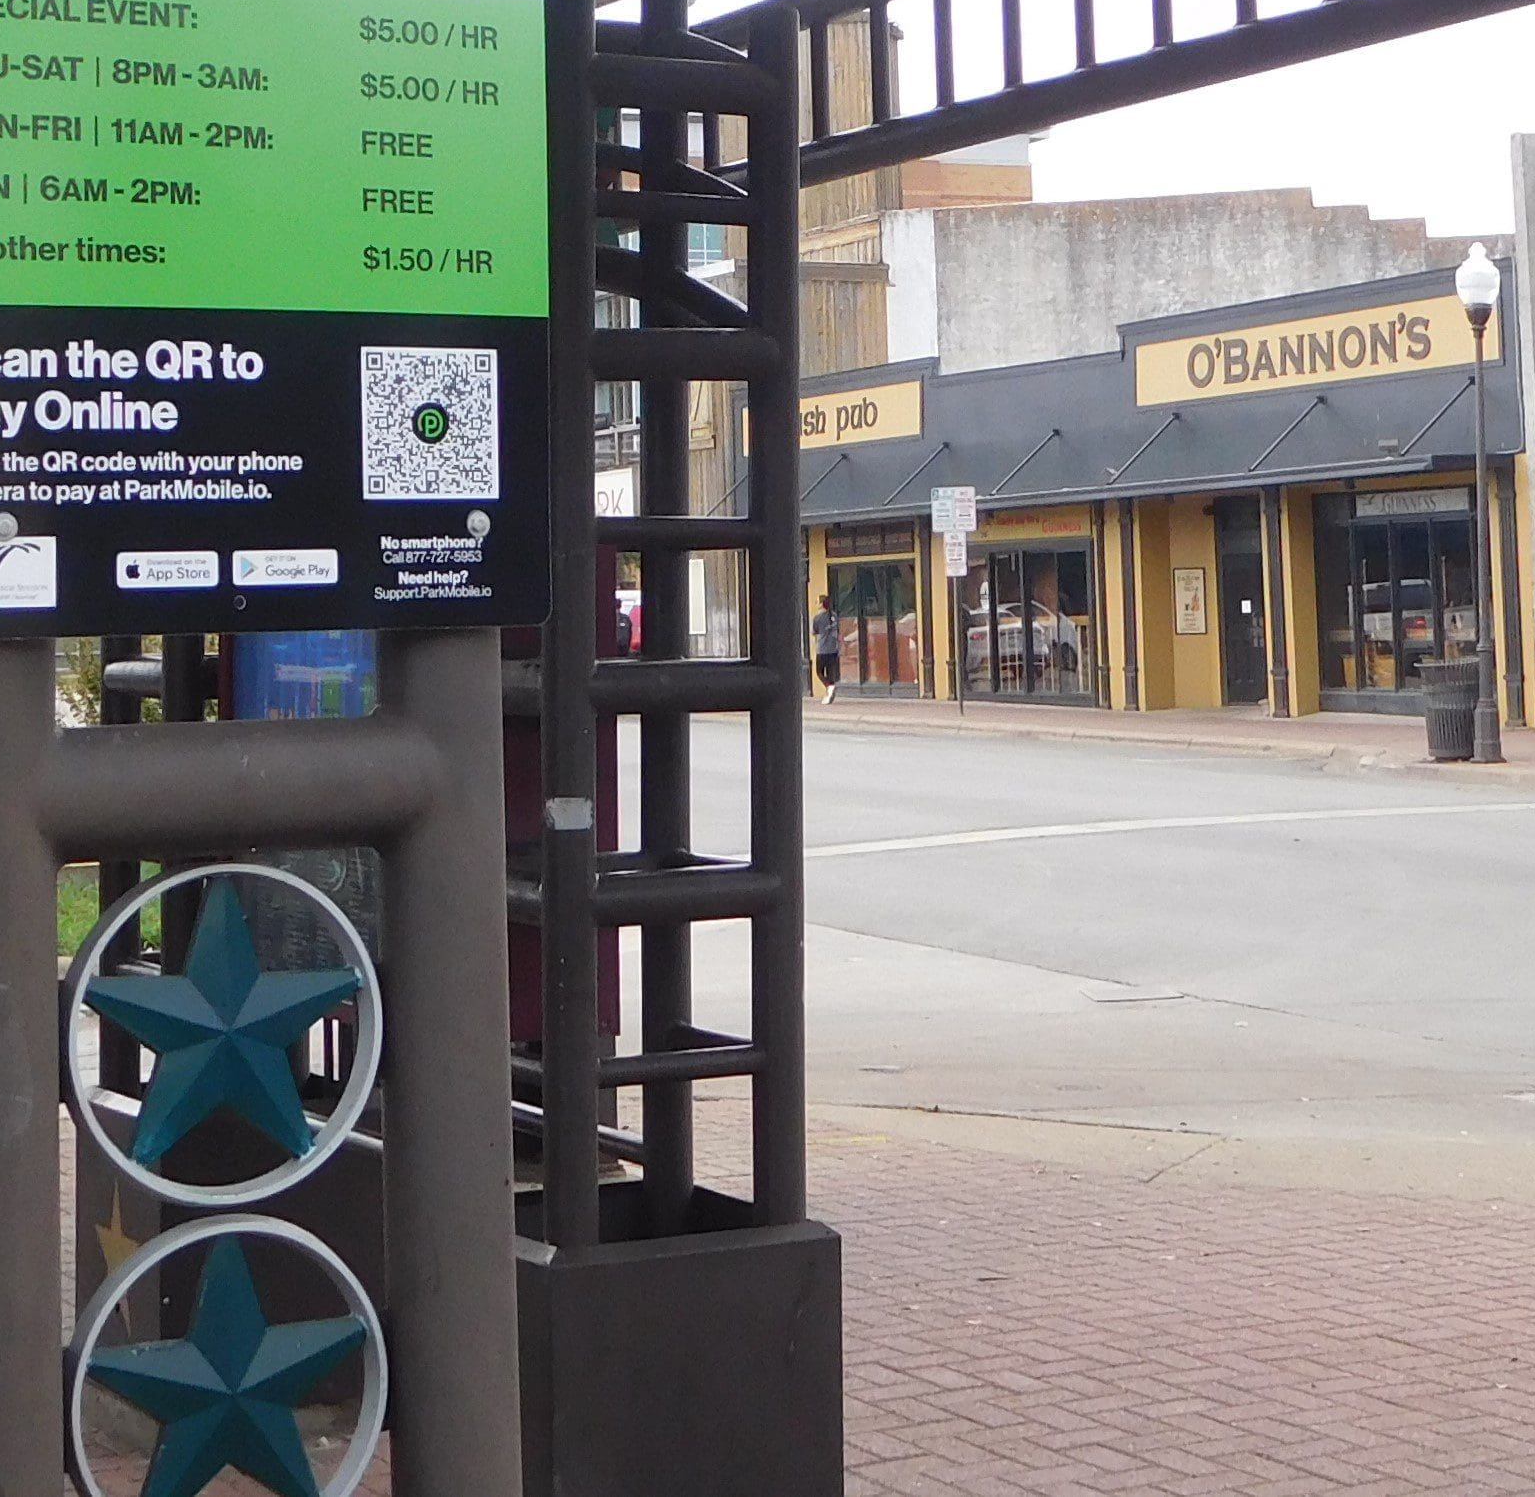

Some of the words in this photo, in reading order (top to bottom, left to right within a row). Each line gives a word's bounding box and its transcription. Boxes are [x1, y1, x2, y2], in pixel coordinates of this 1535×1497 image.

[87, 0, 199, 29] EVENT:
[358, 17, 439, 45] $5.00
[460, 25, 498, 50] HR
[360, 74, 440, 101] $5.00
[462, 81, 499, 105] HR
[361, 131, 434, 158] FREE
[362, 188, 435, 215] FREE
[76, 238, 166, 265] times:
[363, 245, 434, 273] $1.50
[455, 248, 493, 274] HR
[64, 339, 138, 379] the
[145, 341, 214, 382] QR
[218, 345, 264, 380] to
[1187, 312, 1432, 389] O'BANNON'S
[33, 389, 179, 432] Online
[836, 396, 878, 441] pub
[2, 451, 39, 472] the
[42, 451, 78, 474] QR
[80, 451, 137, 473] code
[139, 451, 184, 472] with
[188, 454, 235, 476] your
[238, 451, 303, 475] phone
[28, 481, 53, 501] to
[55, 484, 96, 504] pay
[98, 481, 121, 501] at
[124, 479, 273, 501] ParkMobile.io.
[380, 536, 400, 550] No
[401, 535, 483, 551] smartphone?
[383, 550, 404, 564] Call
[405, 550, 483, 563] 877-727-5953
[147, 568, 174, 582] App
[177, 567, 211, 580] Store
[265, 565, 305, 579] Google
[308, 564, 330, 578] Play
[398, 571, 432, 585] Need
[434, 570, 469, 586] help?
